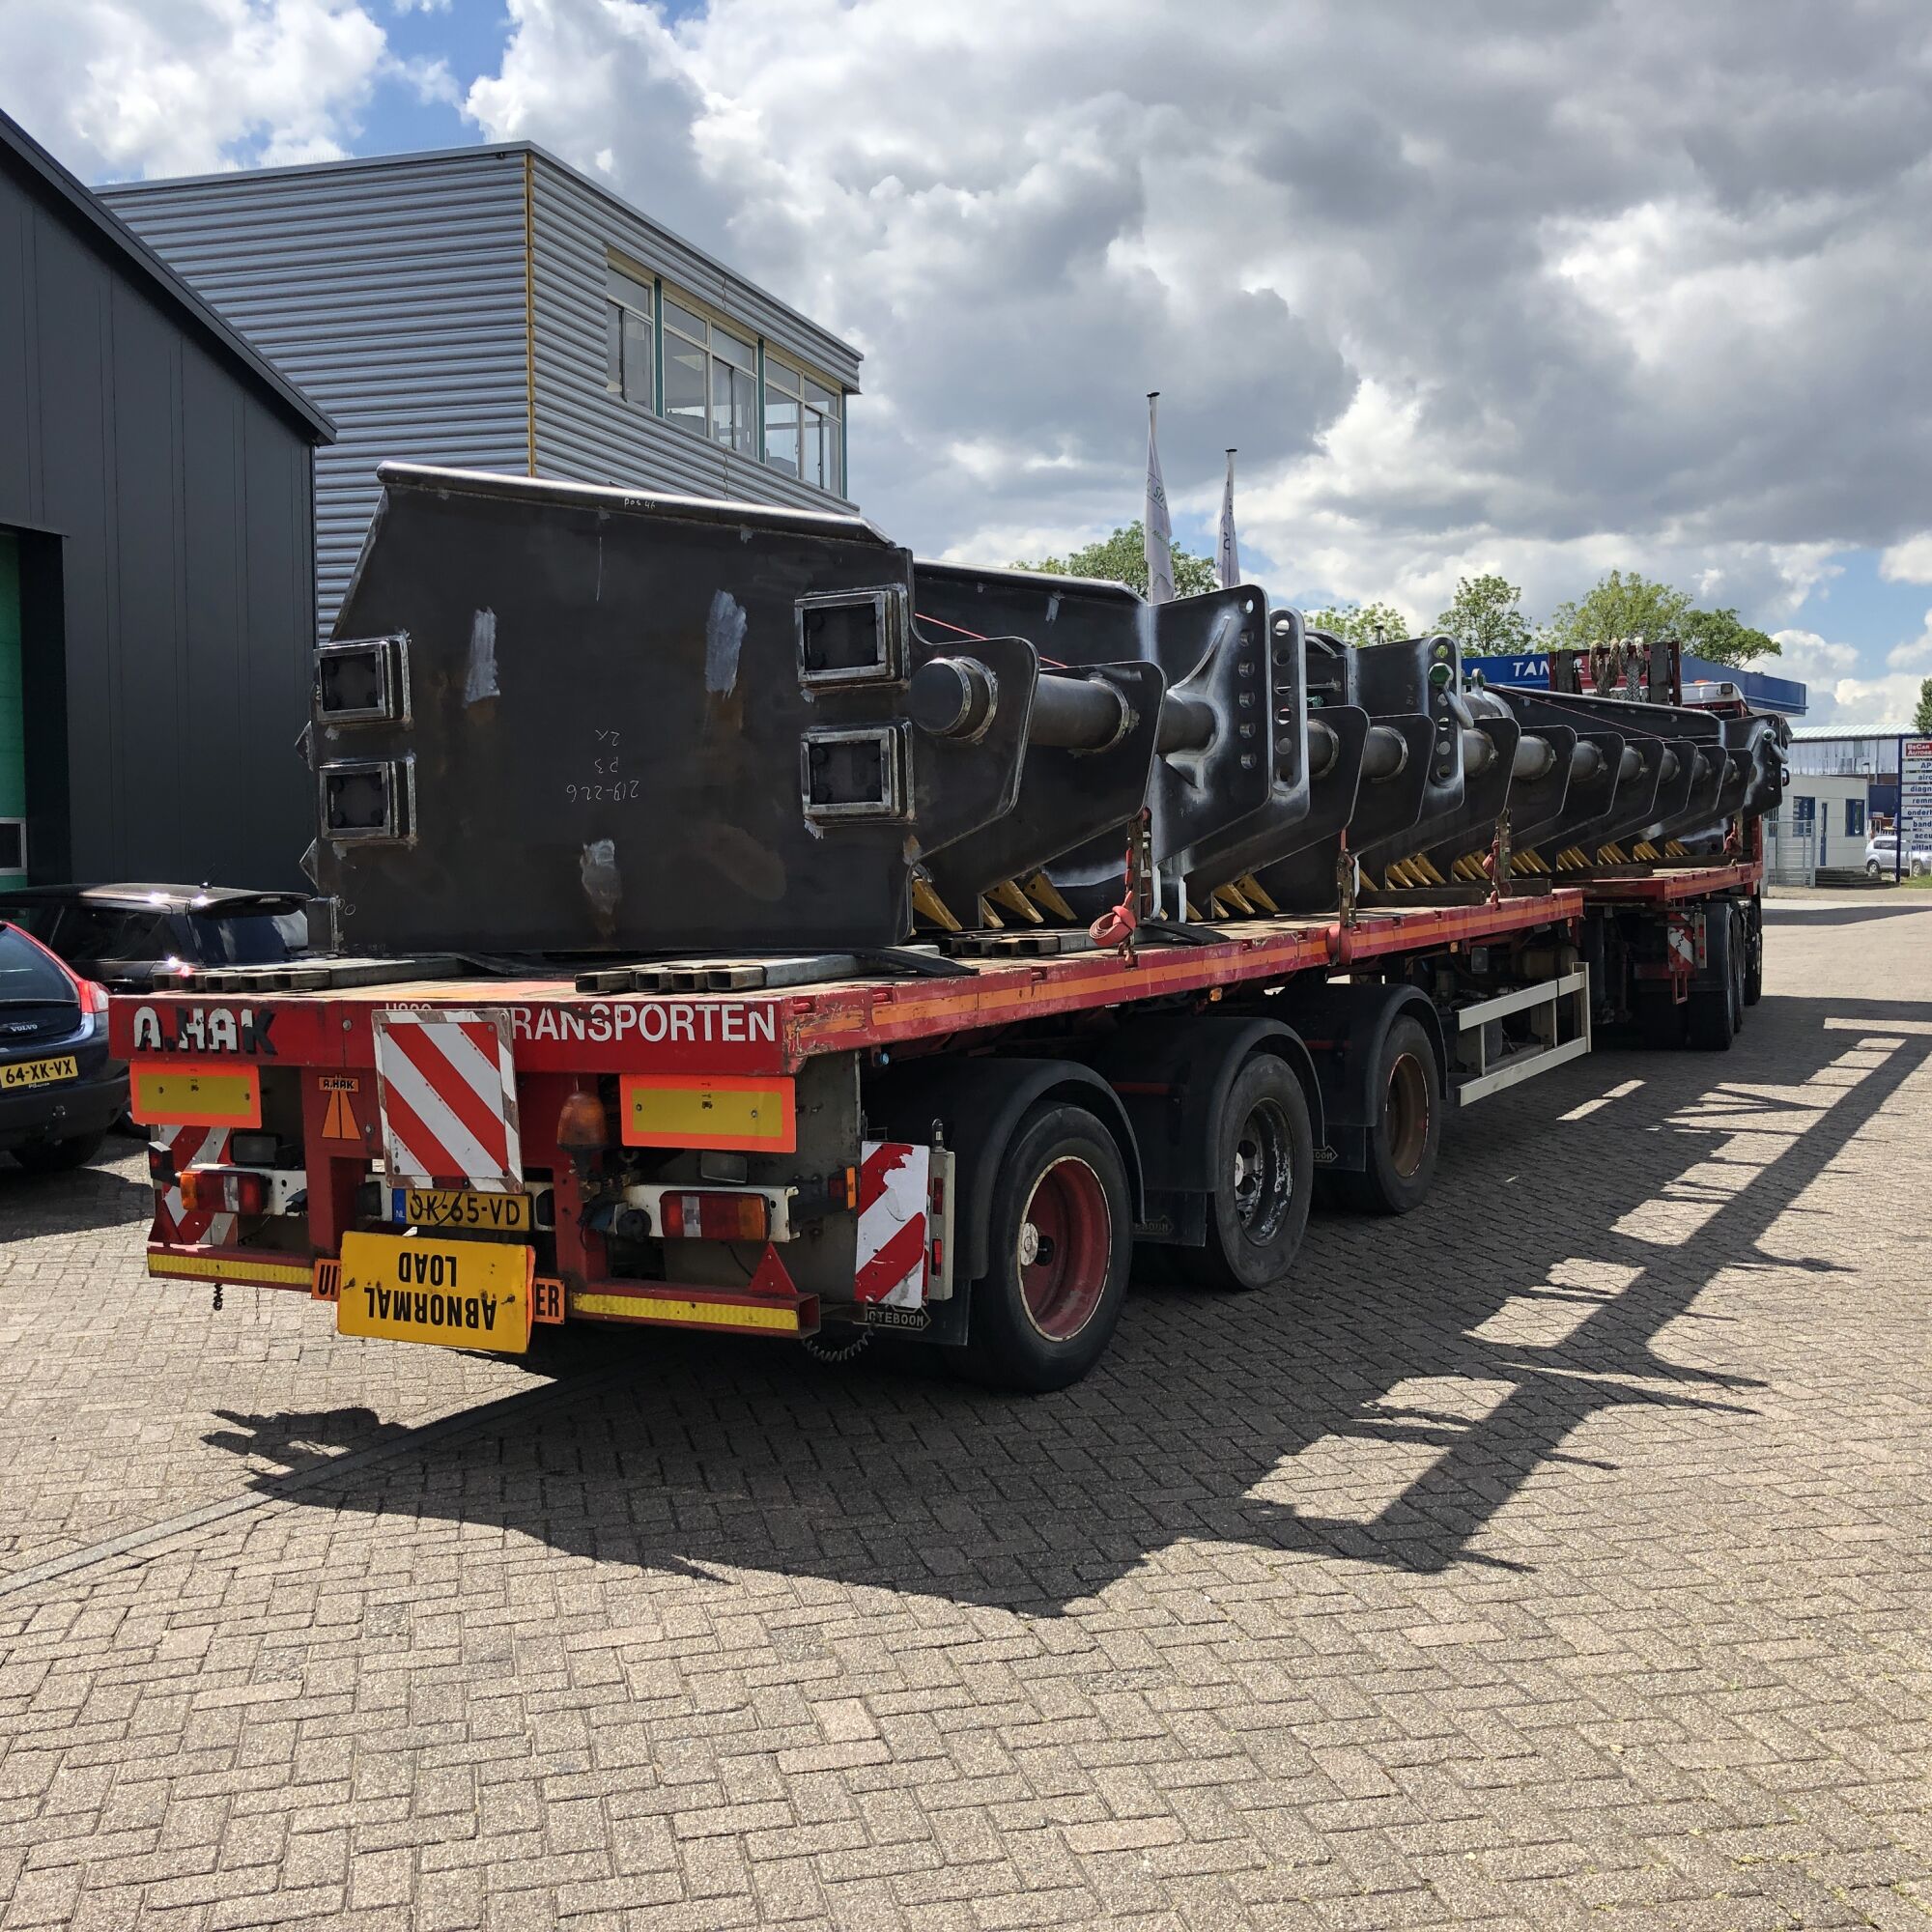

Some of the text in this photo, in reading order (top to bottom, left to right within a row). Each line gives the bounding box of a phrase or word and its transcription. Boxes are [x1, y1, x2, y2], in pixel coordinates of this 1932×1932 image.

[566, 780, 639, 803] 219-226
[11, 1024, 38, 1033] VOLVO
[133, 1007, 278, 1055] A.HAK
[509, 1004, 776, 1042] RANSPORTEN
[6, 1059, 73, 1084] 64-XK-VX
[324, 1078, 355, 1090] A.HAK
[394, 1209, 406, 1219] NL
[410, 1195, 521, 1226] OK-65-VD
[318, 1264, 341, 1295] UI
[398, 1252, 457, 1288] LOAD
[363, 1287, 497, 1331] ABNORMAL
